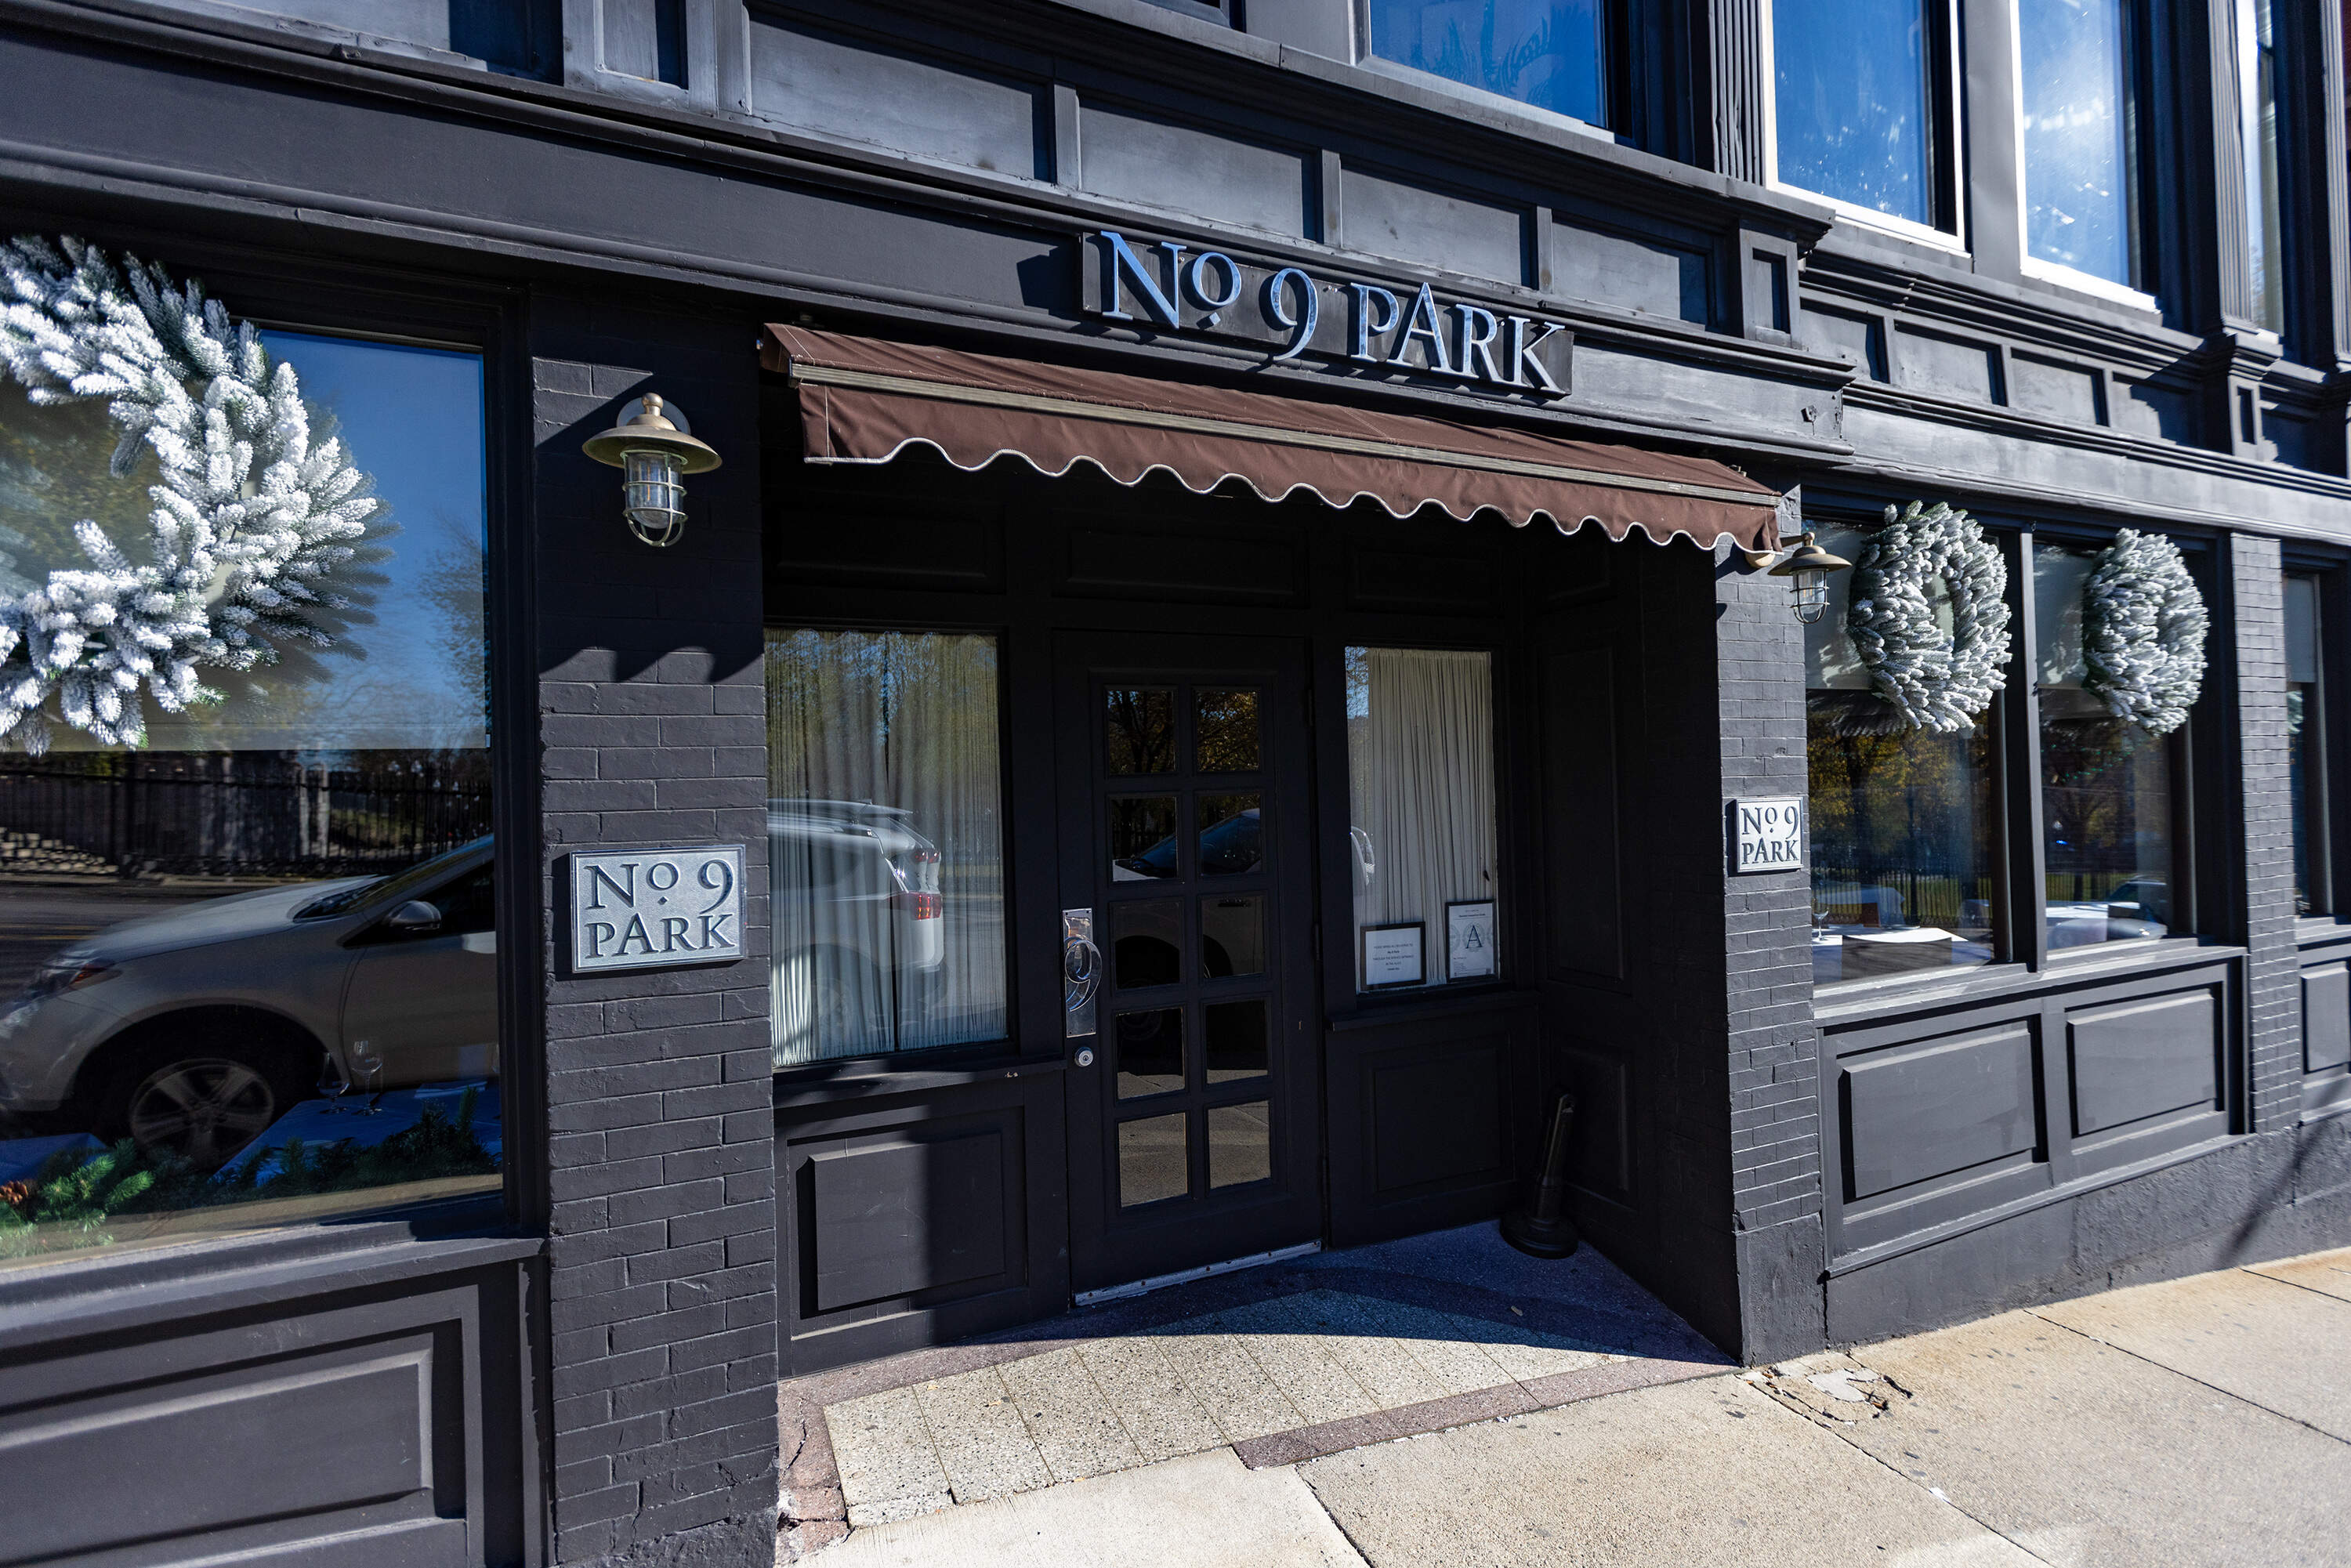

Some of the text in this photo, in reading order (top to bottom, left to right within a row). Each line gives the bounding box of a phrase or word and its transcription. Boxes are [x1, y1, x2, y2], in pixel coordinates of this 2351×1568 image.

[1270, 267, 1320, 361] 9
[1349, 281, 1567, 395] PARK
[1784, 806, 1799, 839] 9
[1741, 837, 1800, 864] PARK
[697, 859, 734, 914] 9
[583, 912, 736, 959] PARK
[1465, 925, 1483, 950] A
[1064, 940, 1103, 1012] 9
